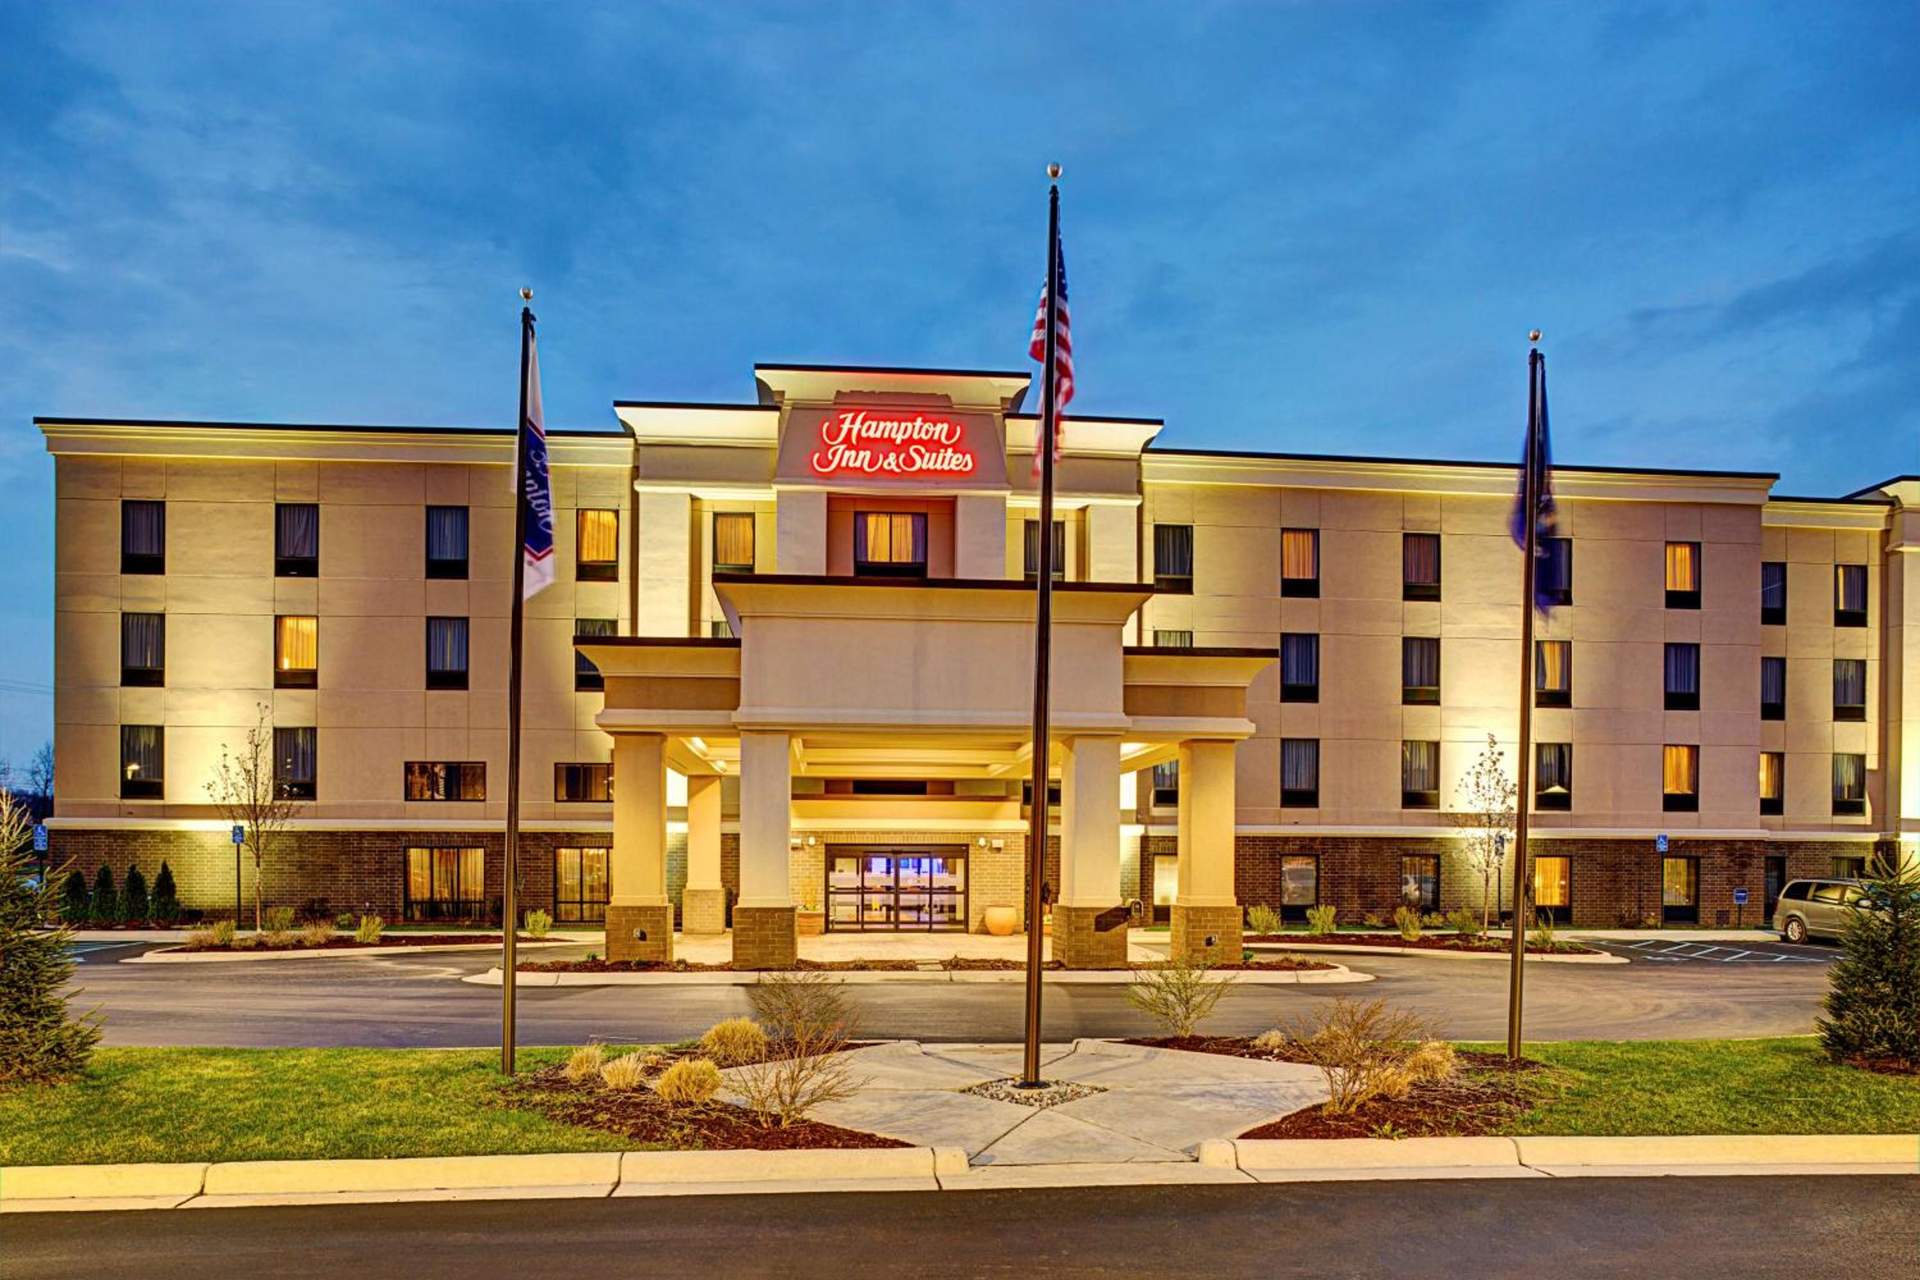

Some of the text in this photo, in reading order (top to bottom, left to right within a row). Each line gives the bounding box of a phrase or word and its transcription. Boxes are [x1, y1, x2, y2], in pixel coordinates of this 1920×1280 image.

[822, 411, 961, 445] Hampton
[812, 444, 974, 472] Inn & Suites
